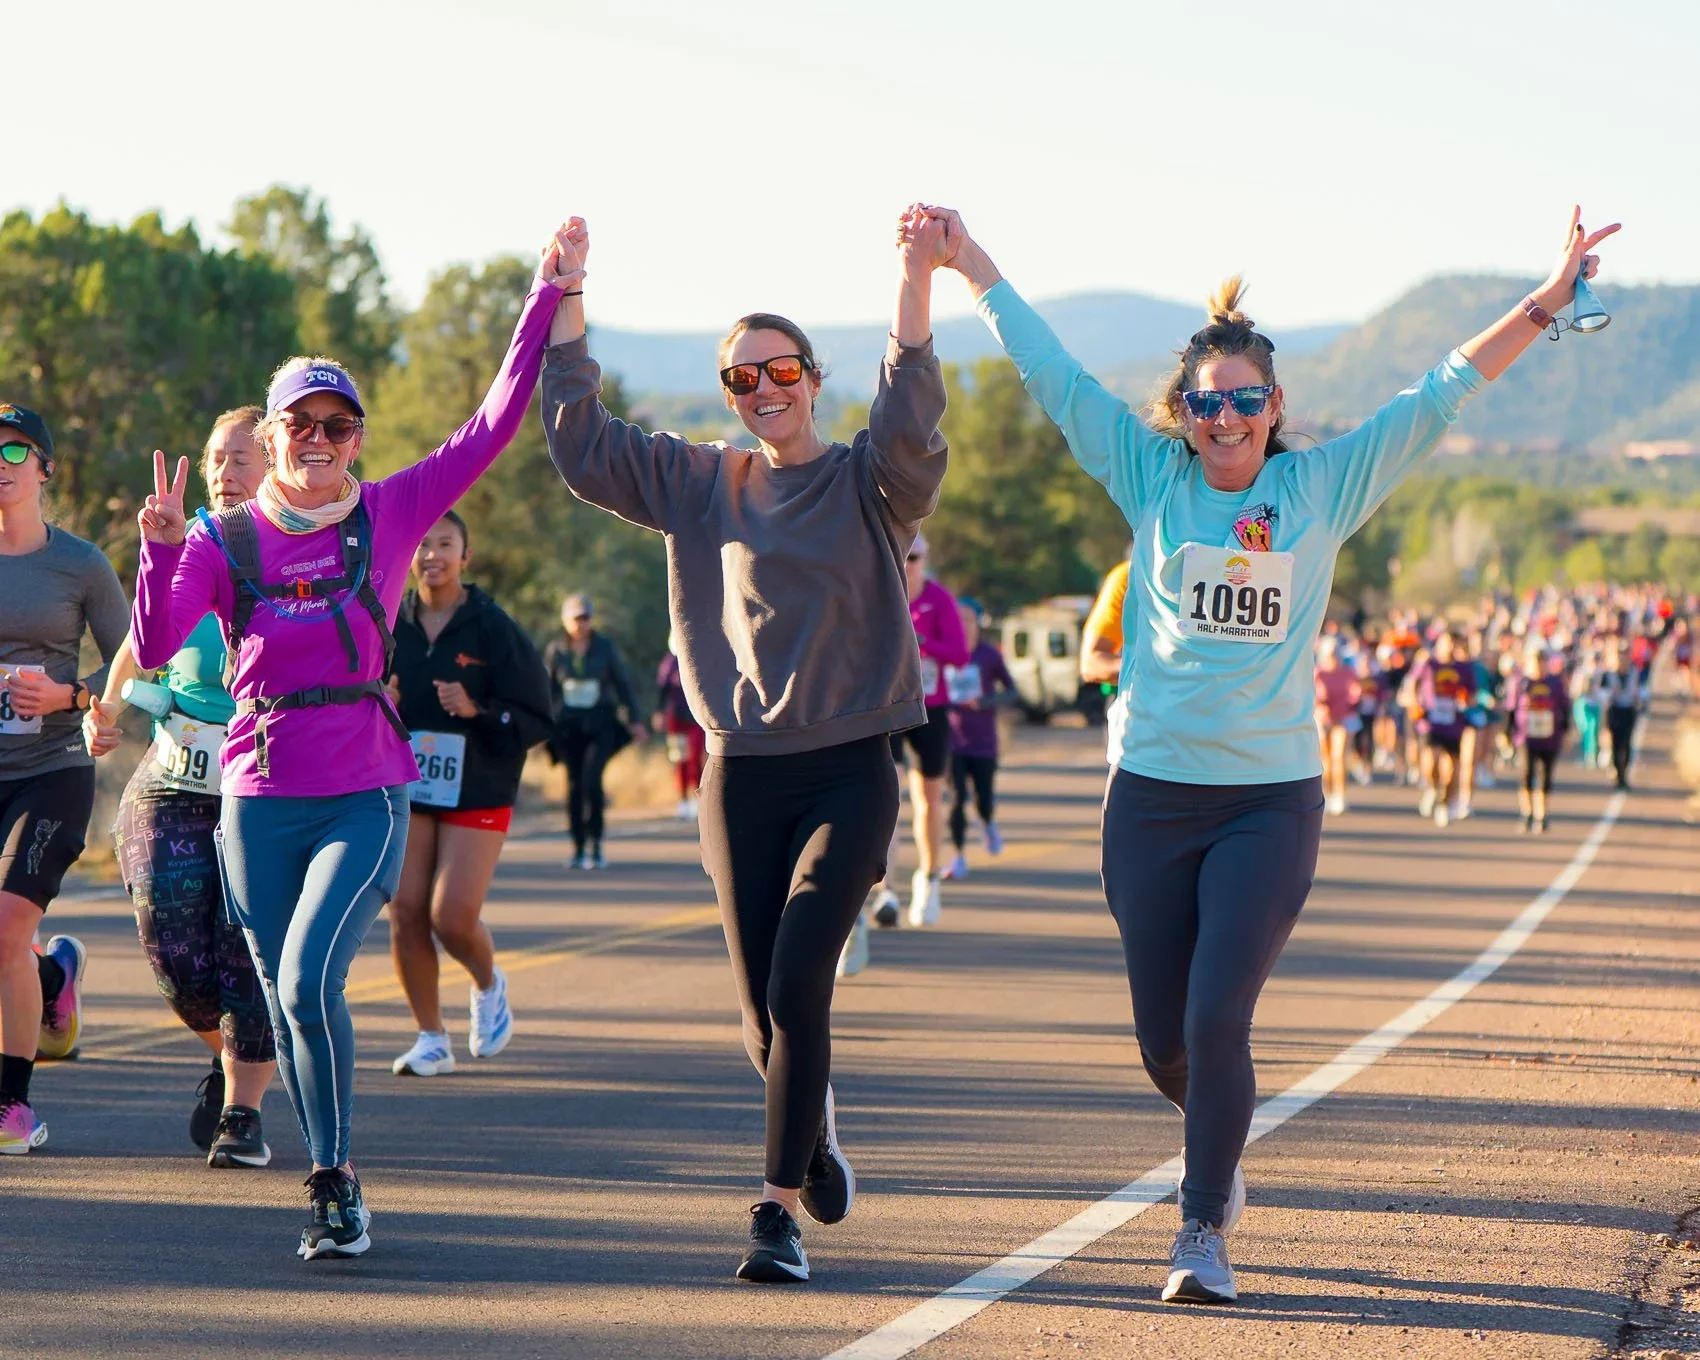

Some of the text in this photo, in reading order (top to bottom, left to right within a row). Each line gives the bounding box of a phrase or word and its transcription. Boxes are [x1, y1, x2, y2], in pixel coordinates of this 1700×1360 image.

[305, 370, 338, 386] TCU
[280, 561, 317, 576] QUEEN
[1190, 581, 1281, 626] 1096
[1197, 623, 1270, 638] HALF MARATHON
[1, 691, 34, 722] 8
[145, 829, 164, 841] 36
[126, 844, 139, 857] He
[169, 839, 197, 856] Kr
[182, 878, 203, 891] Ag
[172, 943, 189, 957] 36
